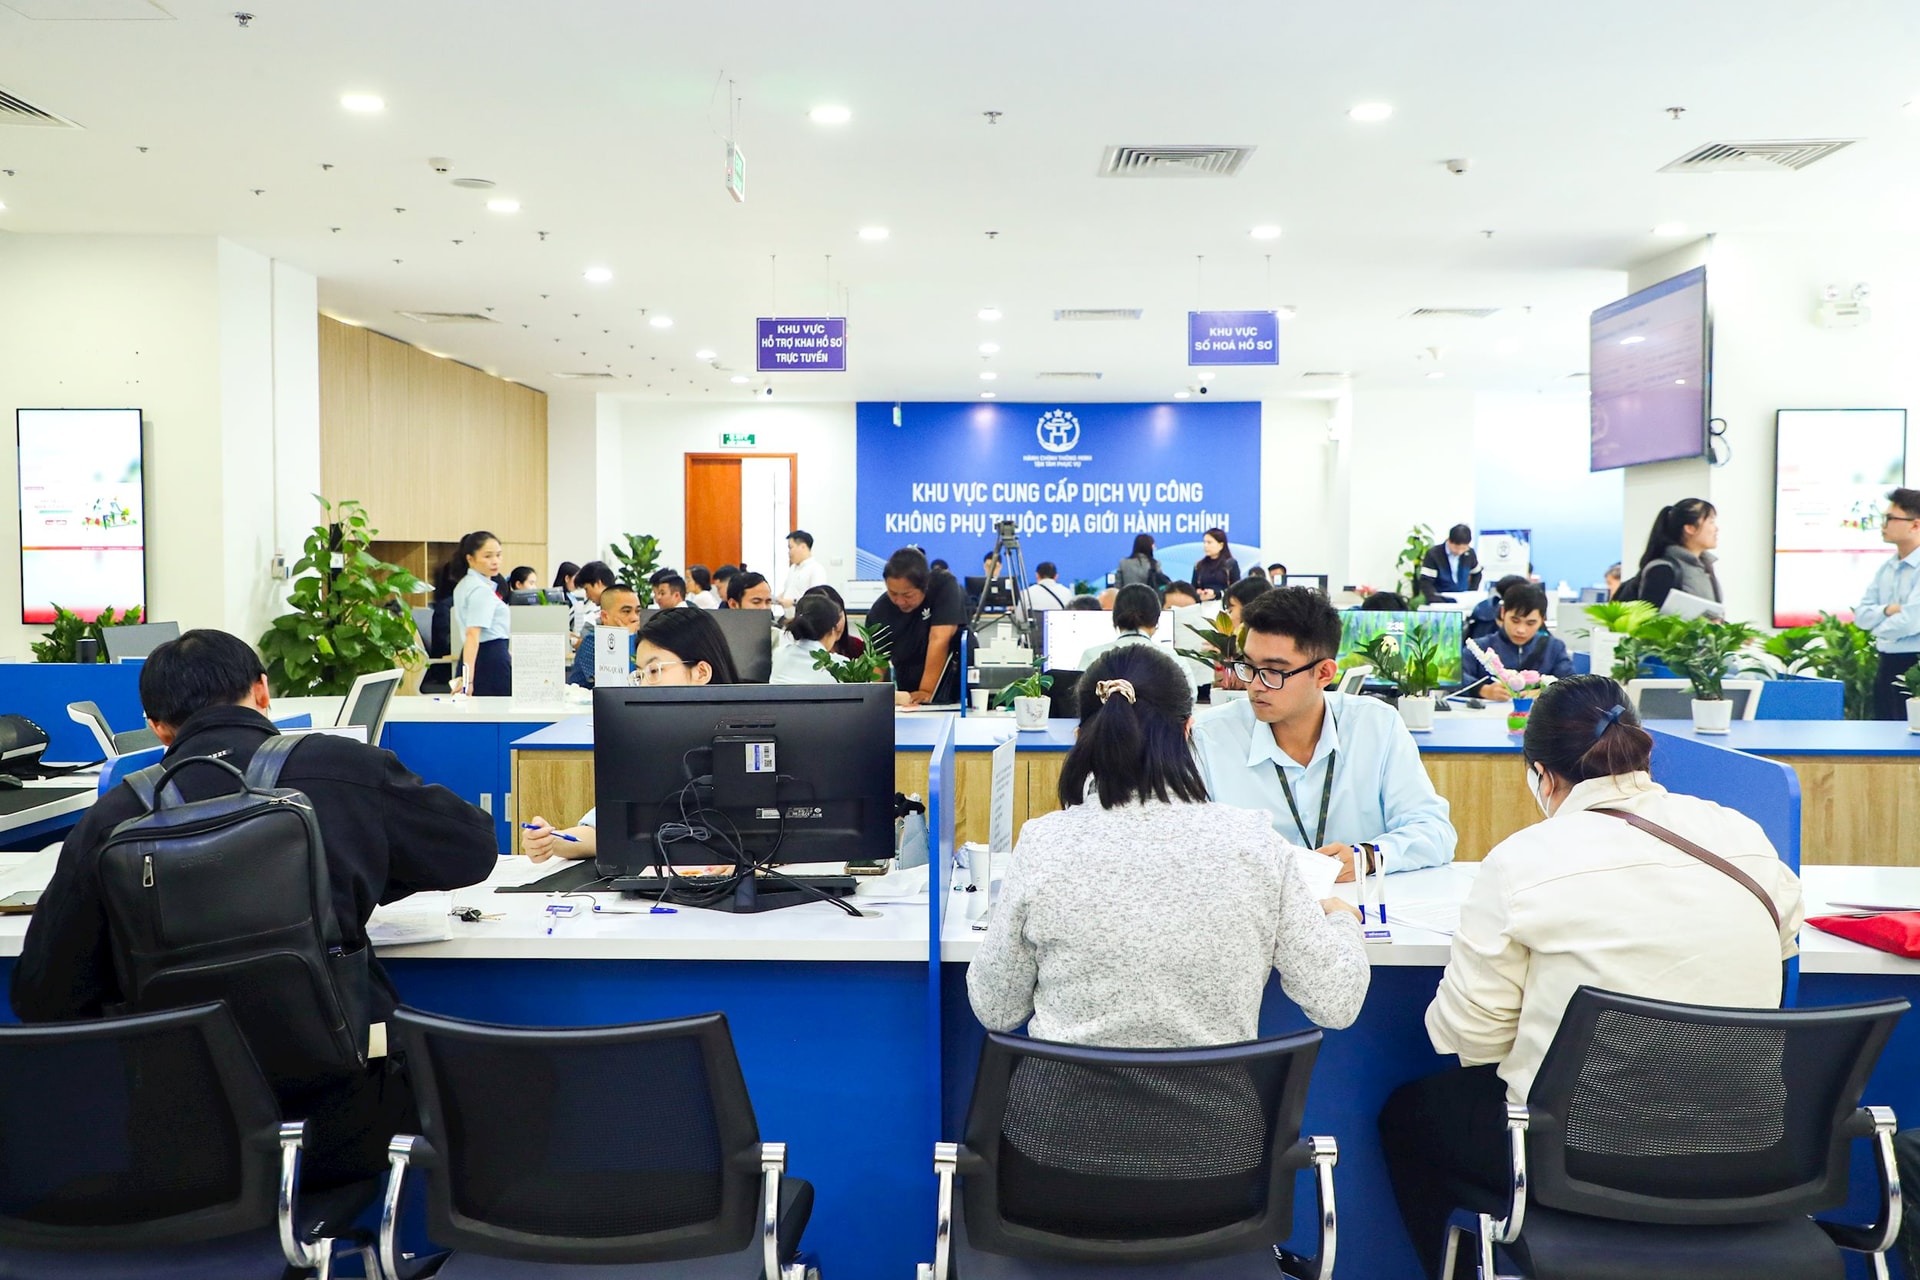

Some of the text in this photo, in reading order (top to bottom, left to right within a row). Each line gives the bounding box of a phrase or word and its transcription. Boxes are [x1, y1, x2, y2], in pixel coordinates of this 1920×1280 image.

[777, 324, 825, 335] KHU VỰC
[1209, 326, 1258, 338] KHU VỰC
[775, 337, 793, 349] TRỢ
[794, 338, 815, 347] KHAI
[830, 337, 842, 347] SƠ
[1194, 338, 1211, 350] SỐ
[1256, 339, 1273, 350] SƠ
[775, 350, 828, 364] TRỰC TUYẾN
[912, 477, 1203, 507] KHU VỰC CUNG CẤP DỊCH VỤ CÔNG
[885, 509, 946, 533] KHÔNG
[951, 513, 986, 538] PHỤ
[1051, 513, 1081, 538] ĐỊA
[1084, 509, 1119, 533] GIỚI
[1123, 509, 1171, 533] HÀNH
[1175, 509, 1230, 533] CHÍNH
